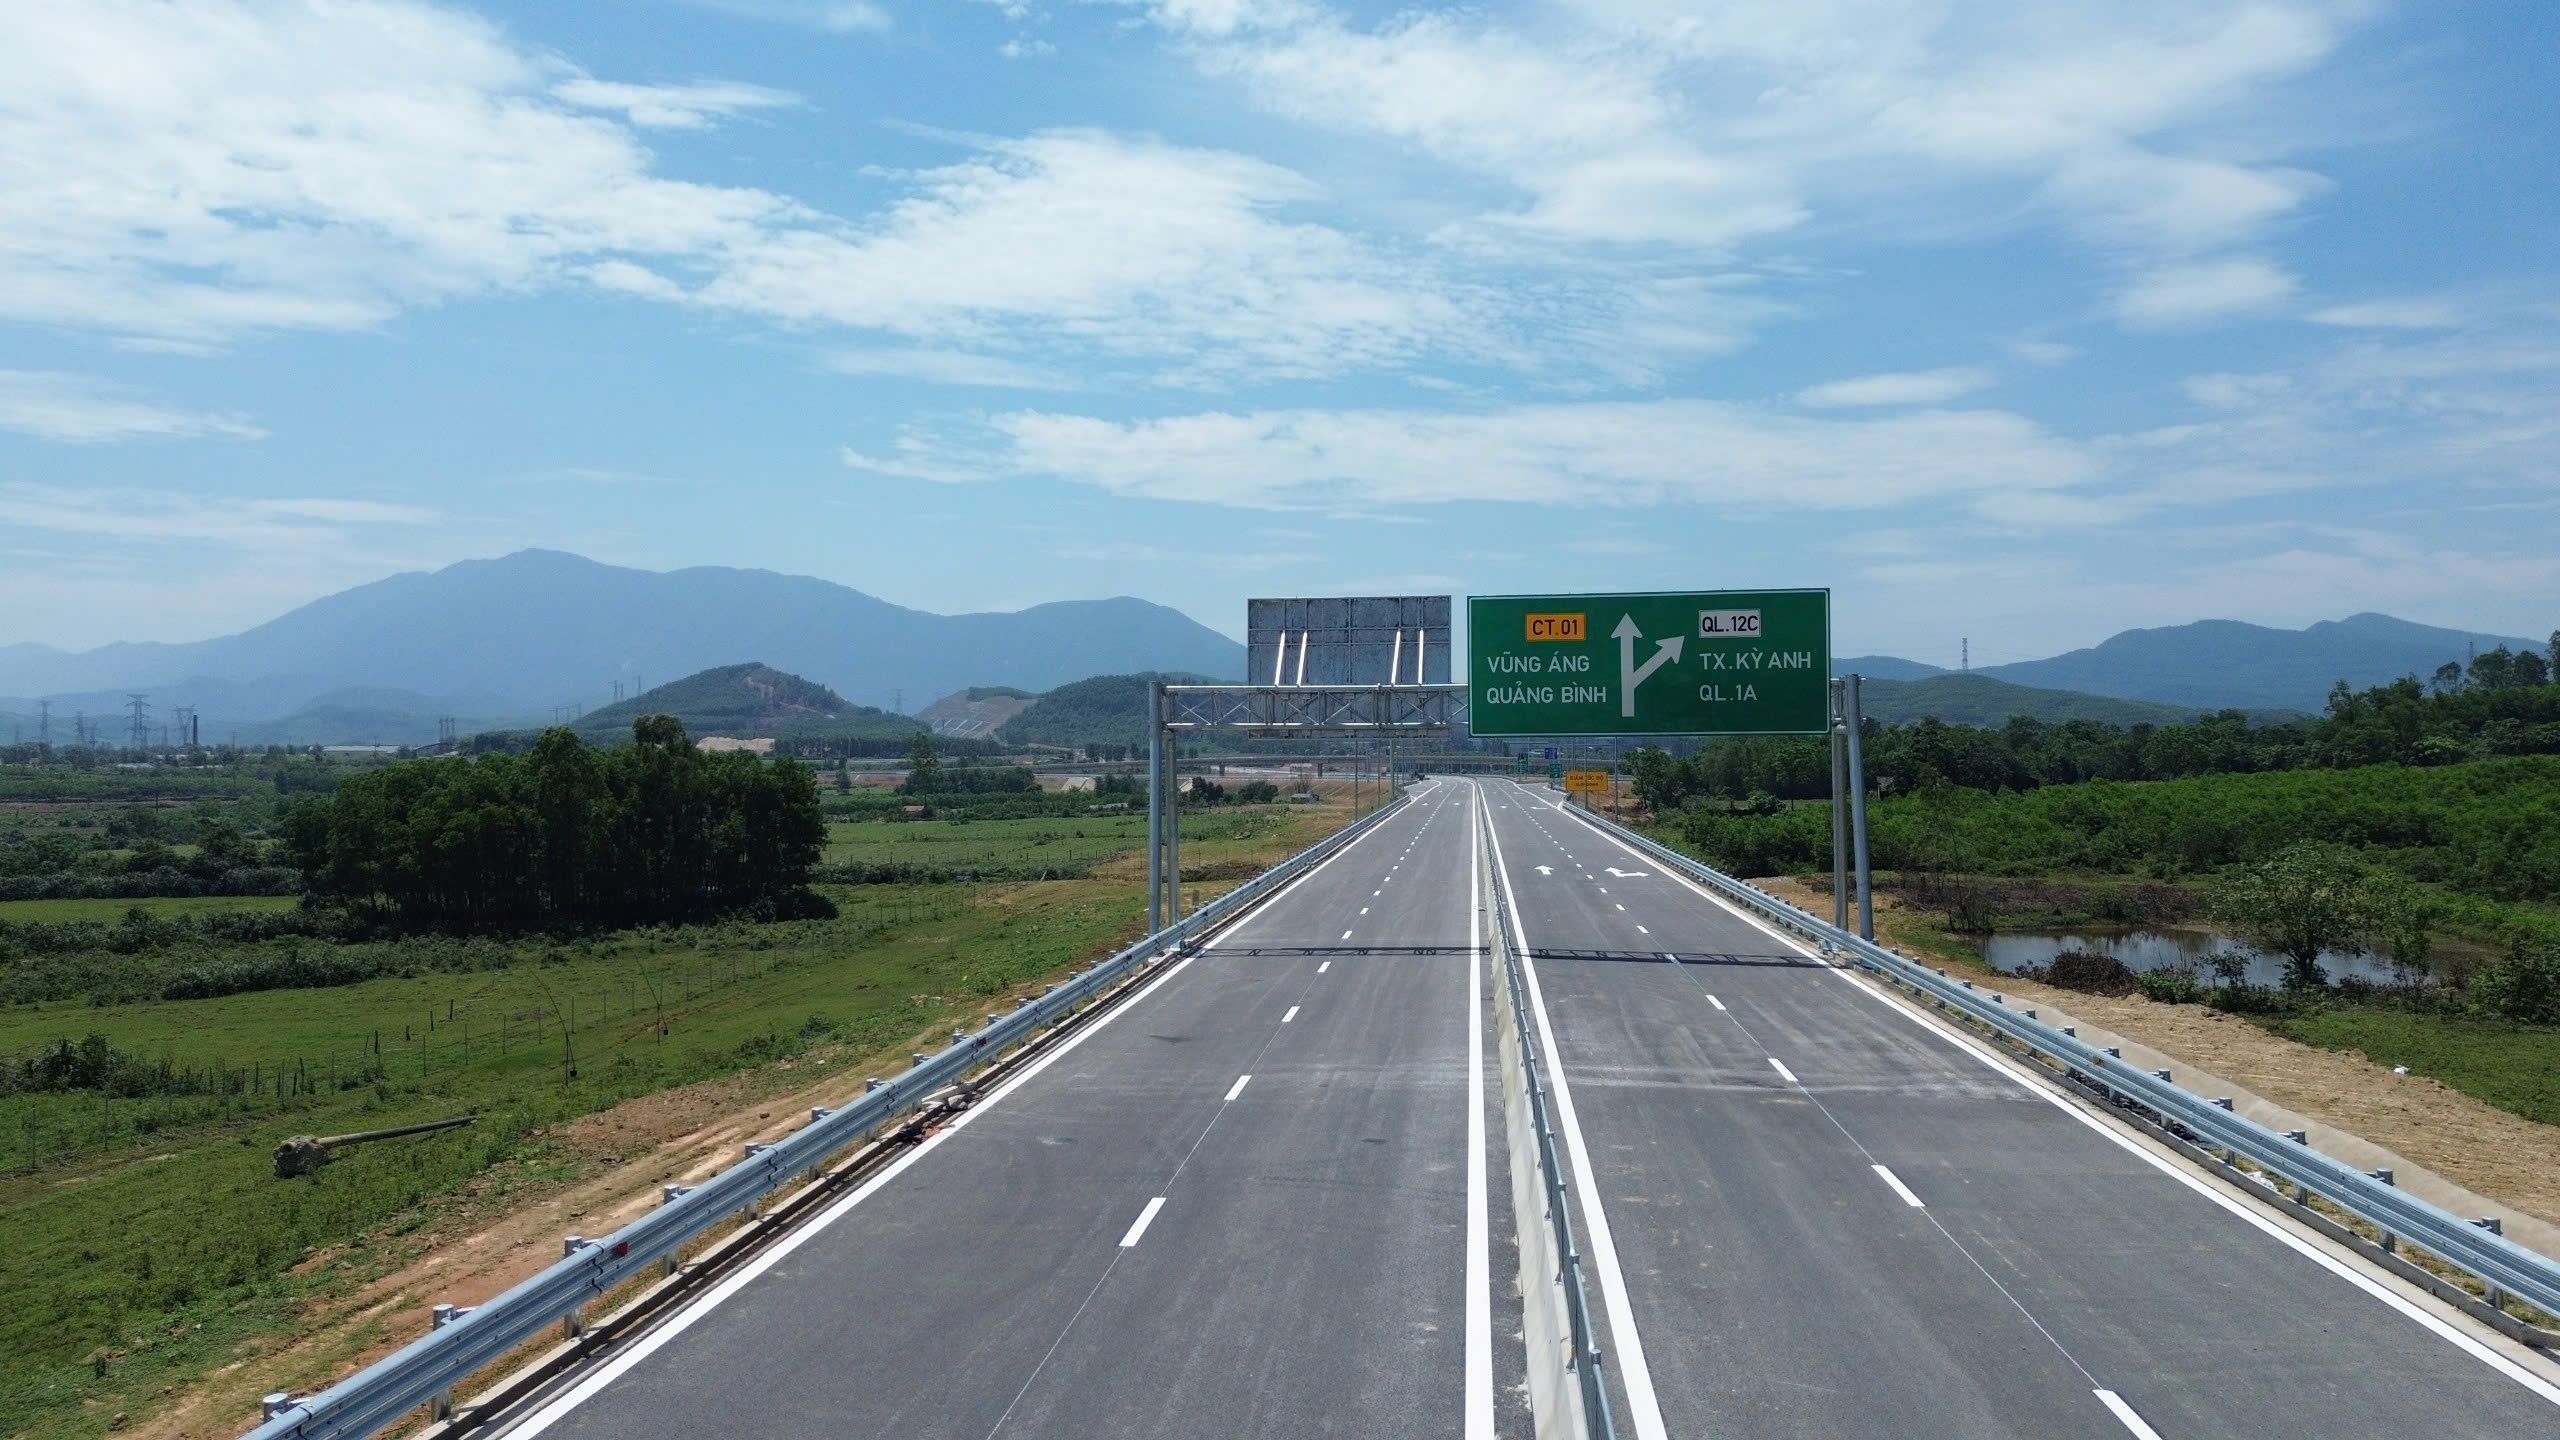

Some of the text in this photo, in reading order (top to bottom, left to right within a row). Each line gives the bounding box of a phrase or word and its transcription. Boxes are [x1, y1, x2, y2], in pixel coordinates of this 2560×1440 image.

[1532, 619, 1578, 636] CT.01
[1702, 615, 1759, 633] QL.12C
[1487, 651, 1590, 673] VŨNG ÁNG
[1699, 647, 1811, 670] TX.KỲ ANH
[1486, 681, 1606, 704] QUẢNG BÌNH
[1699, 685, 1758, 702] QL.1A
